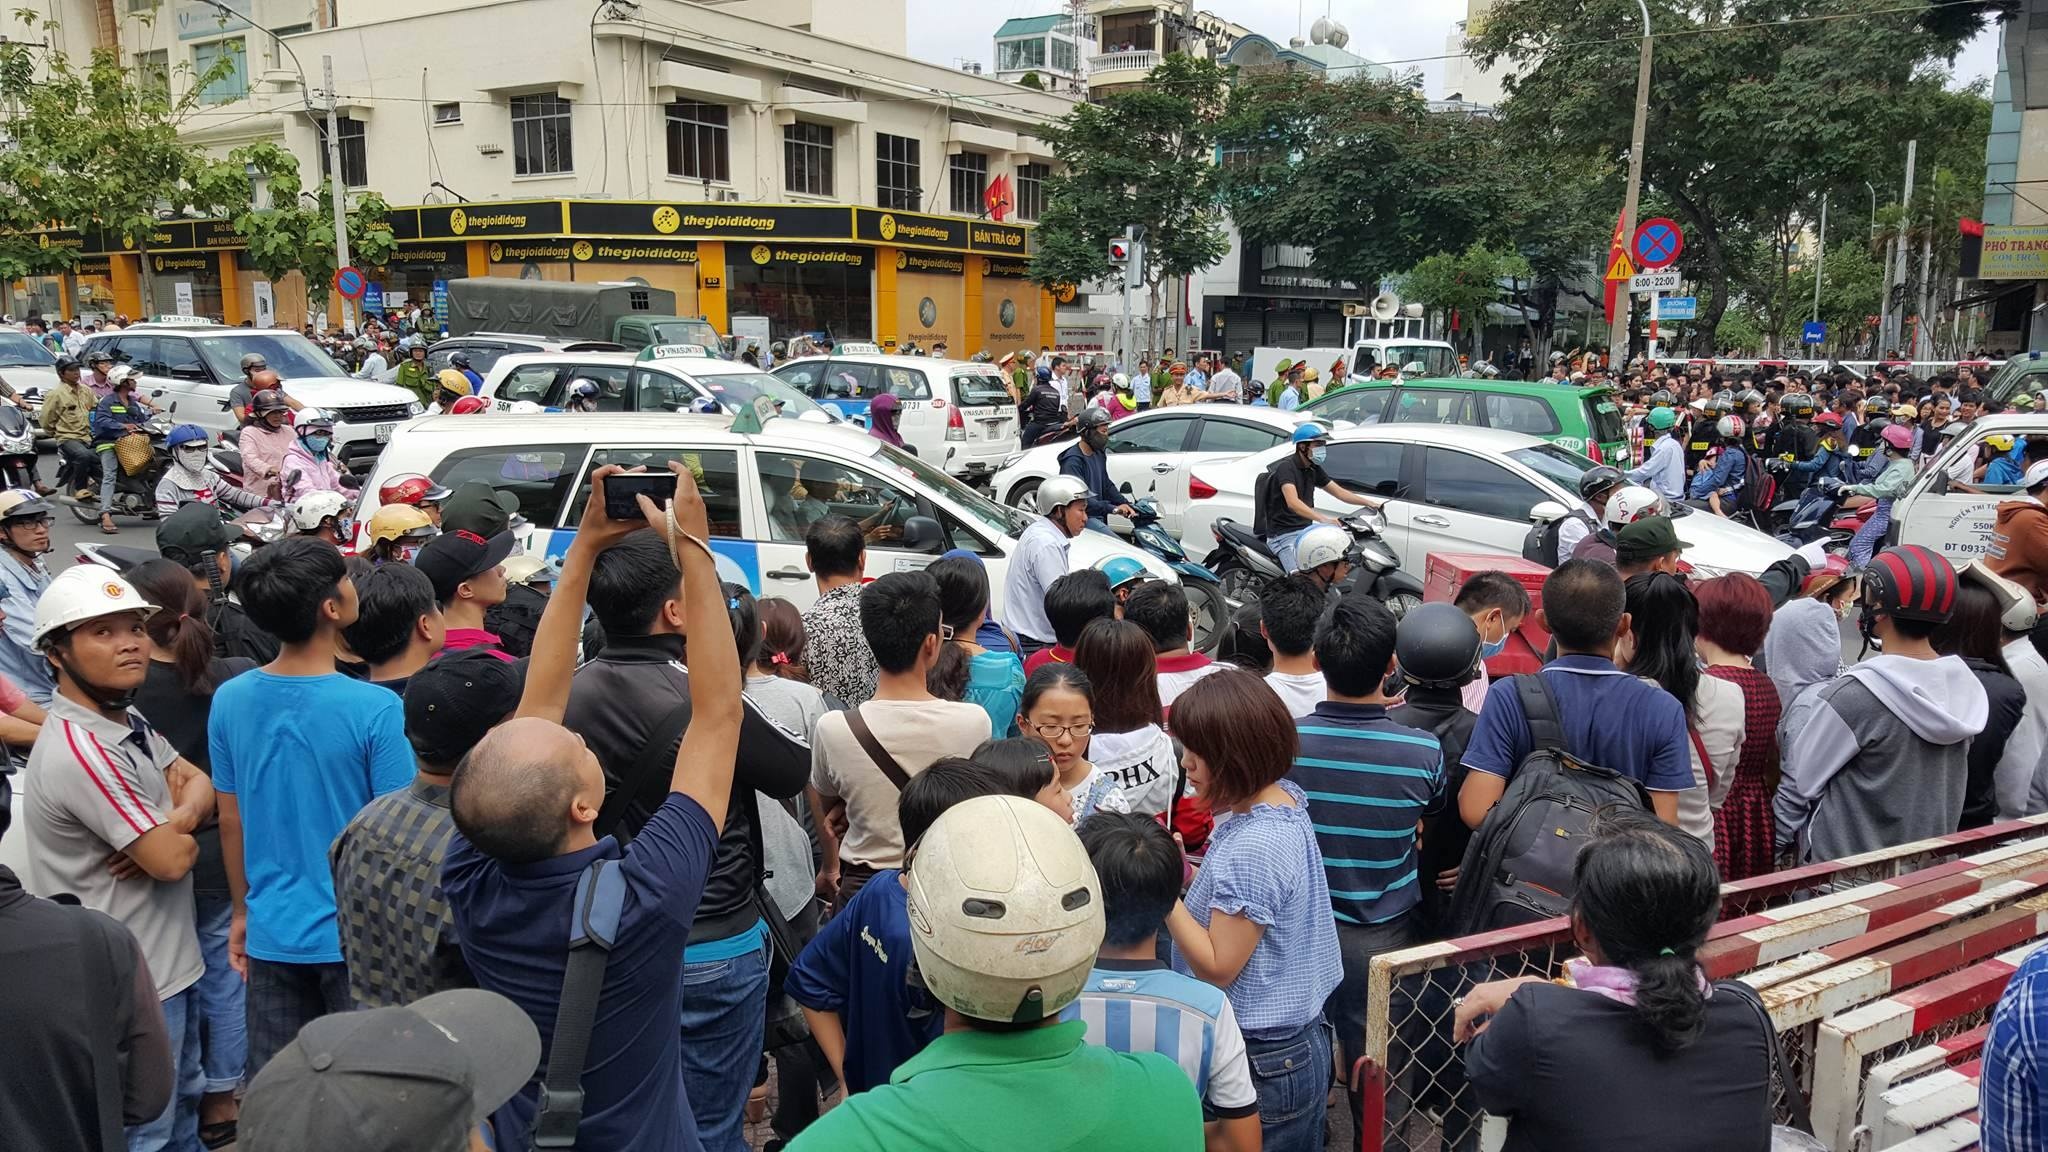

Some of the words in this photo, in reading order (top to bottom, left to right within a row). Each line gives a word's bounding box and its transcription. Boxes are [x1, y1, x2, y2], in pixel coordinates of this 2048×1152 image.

[469, 215, 526, 228] thegioididong
[684, 215, 775, 230] thegioididong
[898, 225, 948, 241] thegioididong
[505, 247, 570, 259] thegioididong
[598, 246, 698, 262] thegioididong
[775, 250, 862, 266] thegioididong
[909, 257, 963, 272] thegioididong
[1635, 278, 1650, 287] 6:00
[1655, 277, 1675, 286] 22:00
